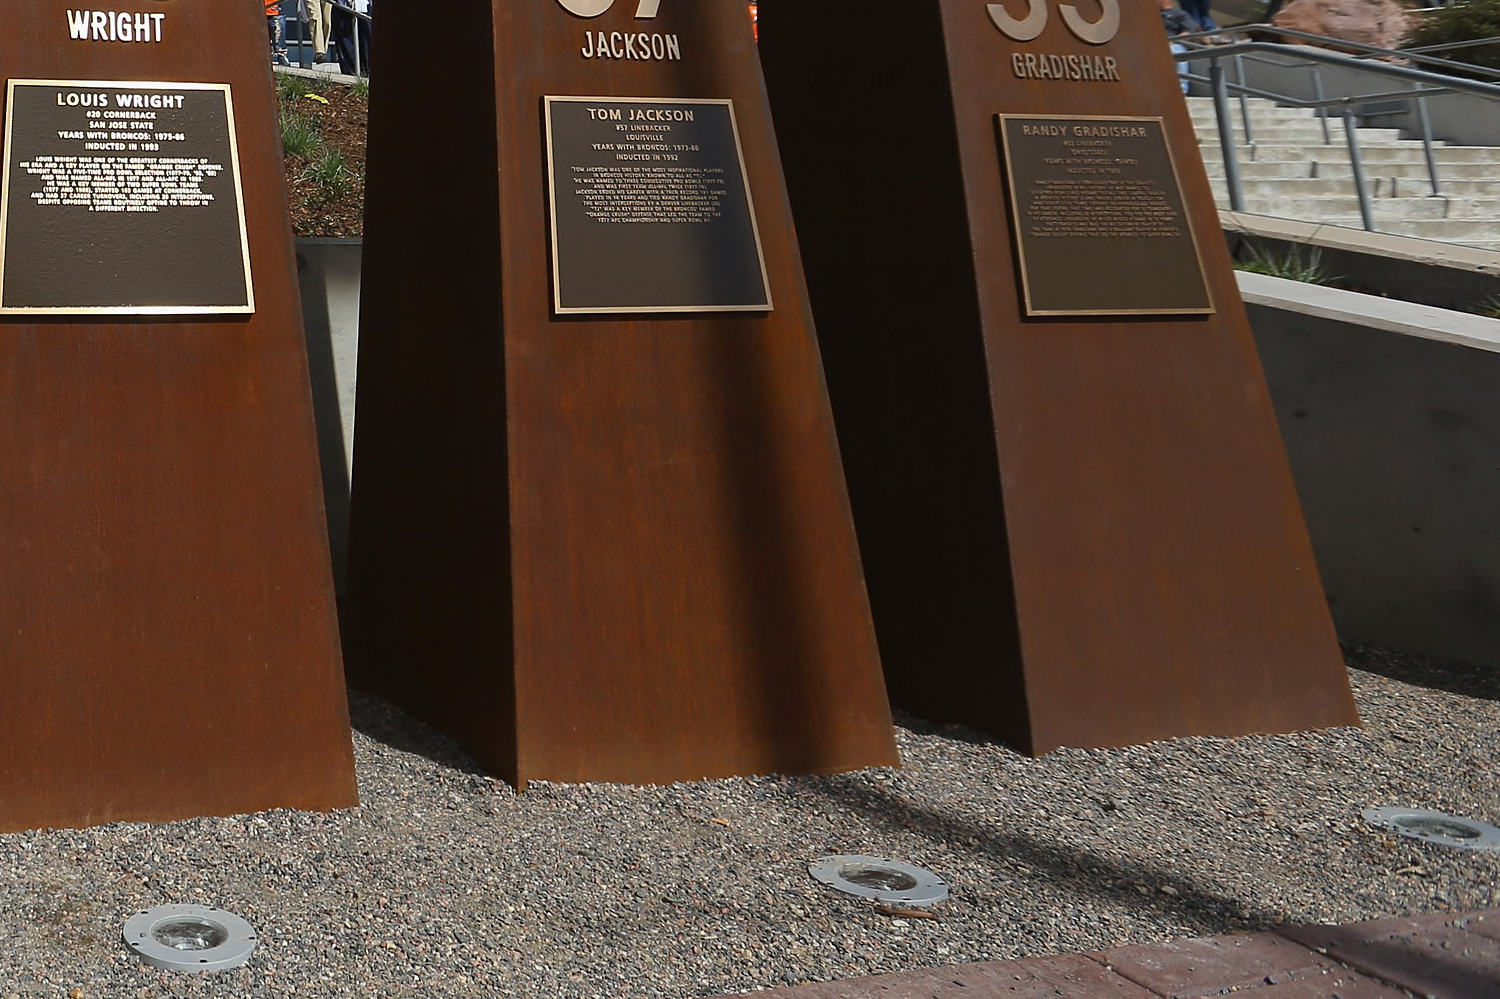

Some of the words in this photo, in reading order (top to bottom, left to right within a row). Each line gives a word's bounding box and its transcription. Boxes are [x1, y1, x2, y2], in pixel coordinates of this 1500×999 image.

[66, 9, 165, 42] WRIGHT
[581, 31, 680, 60] JACKSON
[1012, 53, 1121, 80] GRADISHAR
[57, 93, 108, 106] LOUIS
[116, 94, 185, 108] WRIGHT
[103, 111, 156, 119] CORNERBACK
[587, 108, 621, 120] TOM
[629, 109, 694, 121] JACKSON
[89, 121, 105, 129] SAN
[108, 121, 127, 129] JOSE
[130, 122, 154, 130] STATE
[1023, 125, 1067, 136] RANDY
[1073, 126, 1148, 137] GRADISHAR
[58, 131, 84, 139] YEARS
[87, 132, 108, 140] WITH
[111, 132, 151, 140] BRONCOS:
[154, 133, 185, 141] 1975-86
[85, 142, 125, 151] INDUCTED
[129, 143, 138, 151] IN
